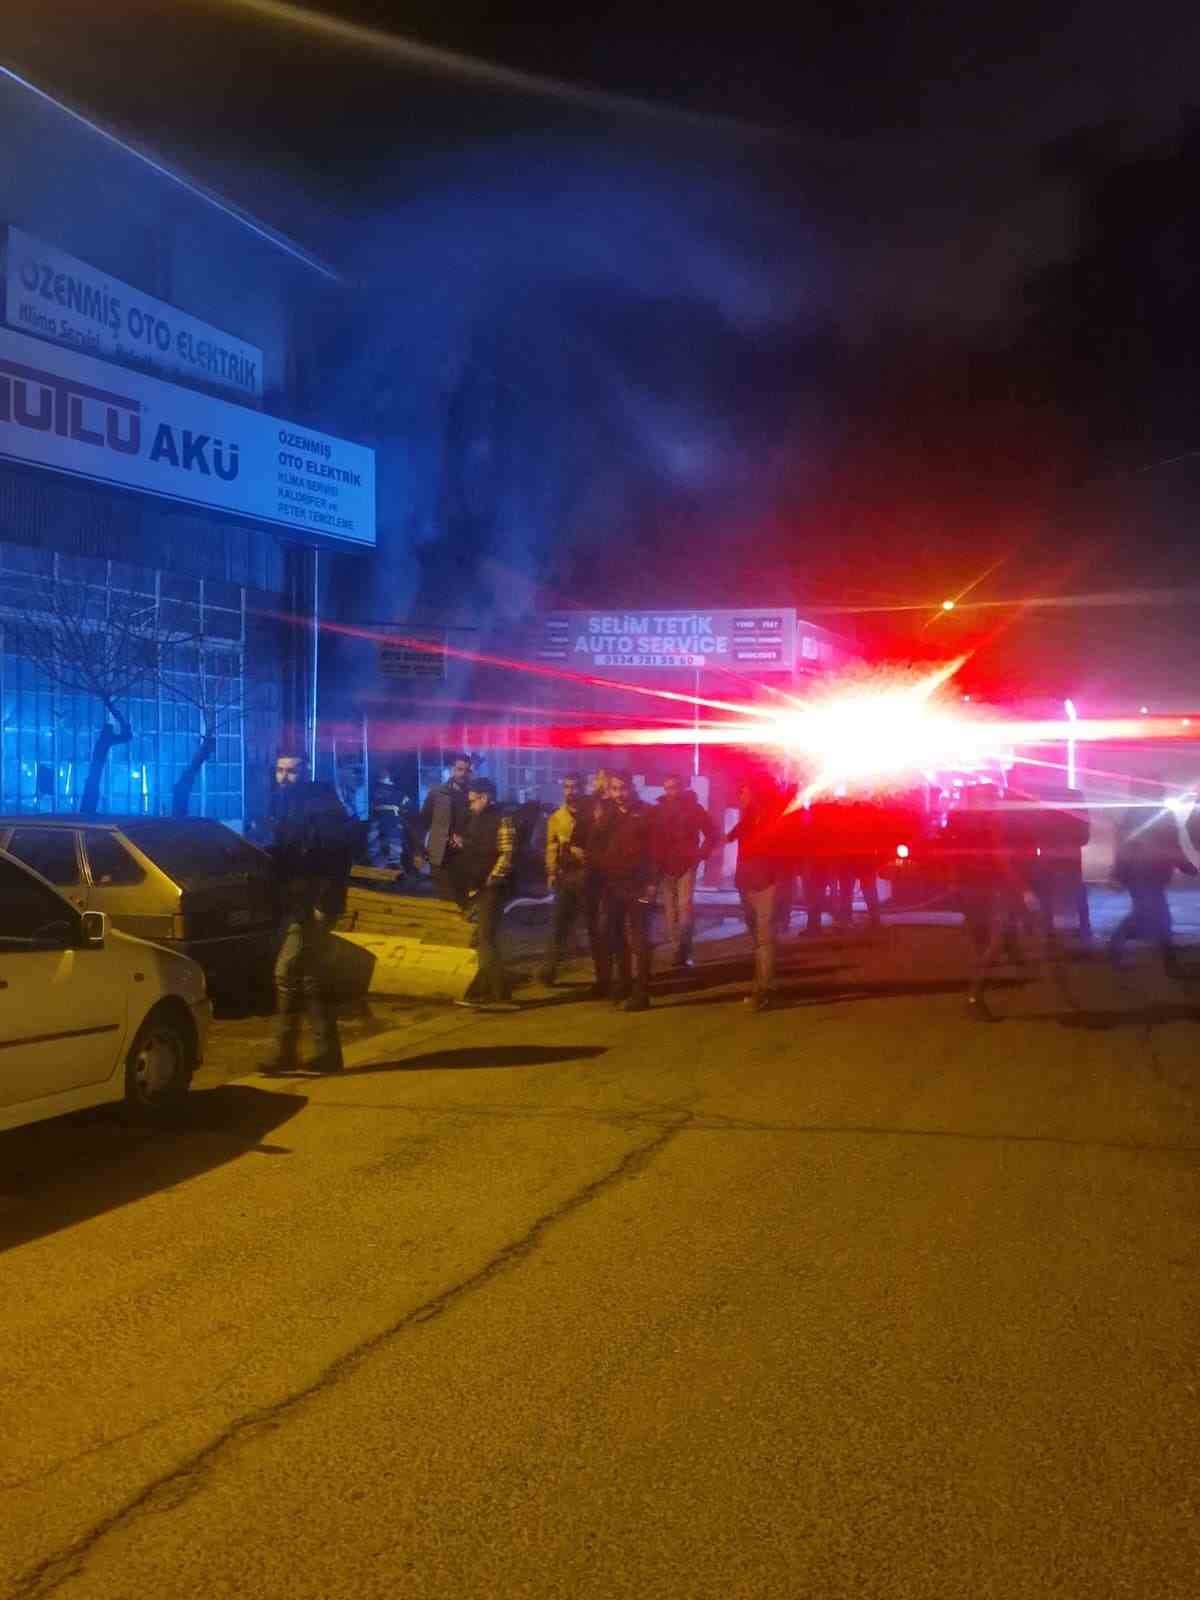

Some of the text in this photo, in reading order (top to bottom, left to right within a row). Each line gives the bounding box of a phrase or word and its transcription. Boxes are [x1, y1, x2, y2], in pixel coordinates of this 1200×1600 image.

[128, 307, 170, 351] OTO
[176, 330, 257, 393] ELEKTRİK
[149, 421, 239, 481] AKÜ
[279, 429, 332, 461] ÖZENMİŞ
[278, 451, 361, 487] OTO ELEKTRİK
[588, 615, 649, 634] SELİM
[653, 614, 712, 634] TETİK
[574, 635, 633, 653] AUTO
